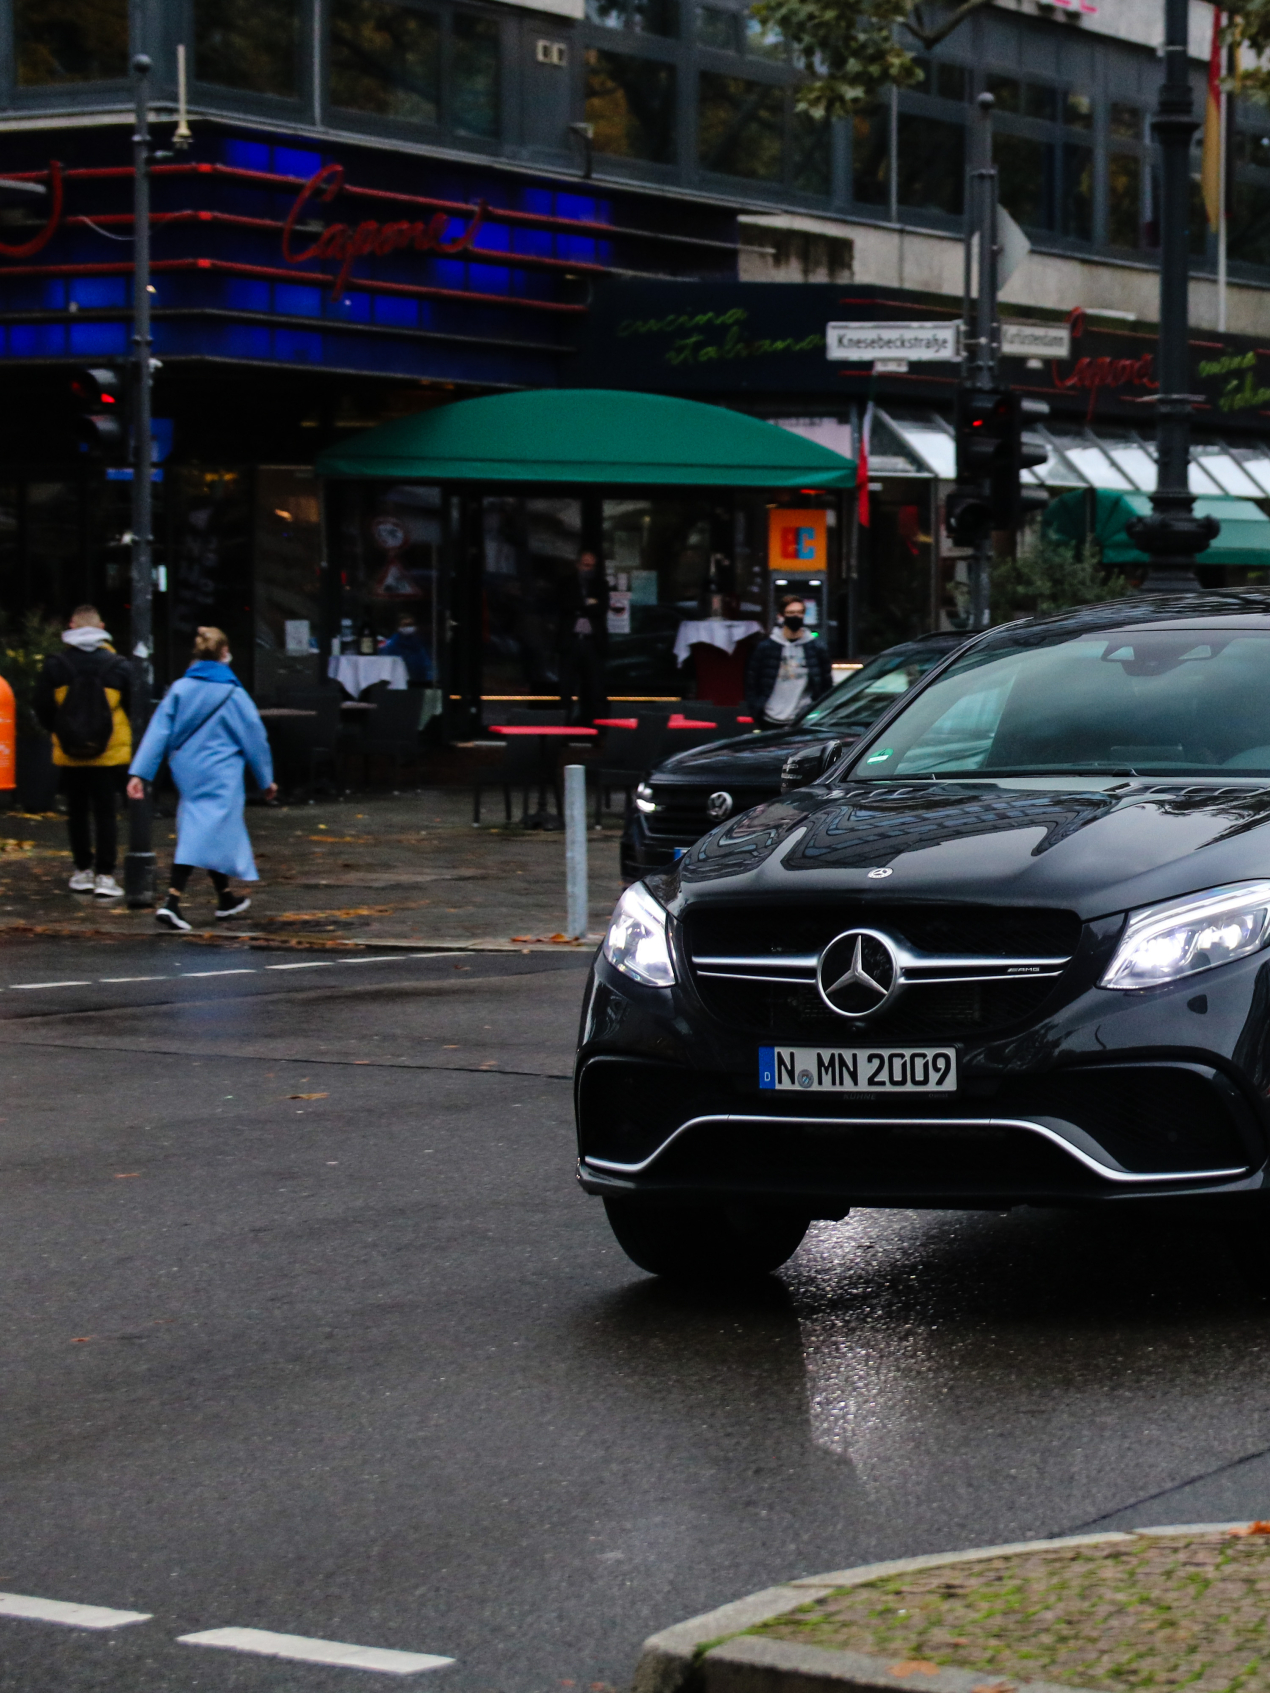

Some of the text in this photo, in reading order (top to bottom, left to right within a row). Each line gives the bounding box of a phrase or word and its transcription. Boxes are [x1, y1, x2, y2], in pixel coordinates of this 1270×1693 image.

[282, 163, 487, 303] Capone
[836, 333, 948, 352] Knesebeckstraße
[781, 526, 816, 560] EC
[764, 1072, 771, 1082] D
[777, 1051, 952, 1086] N MN 2009
